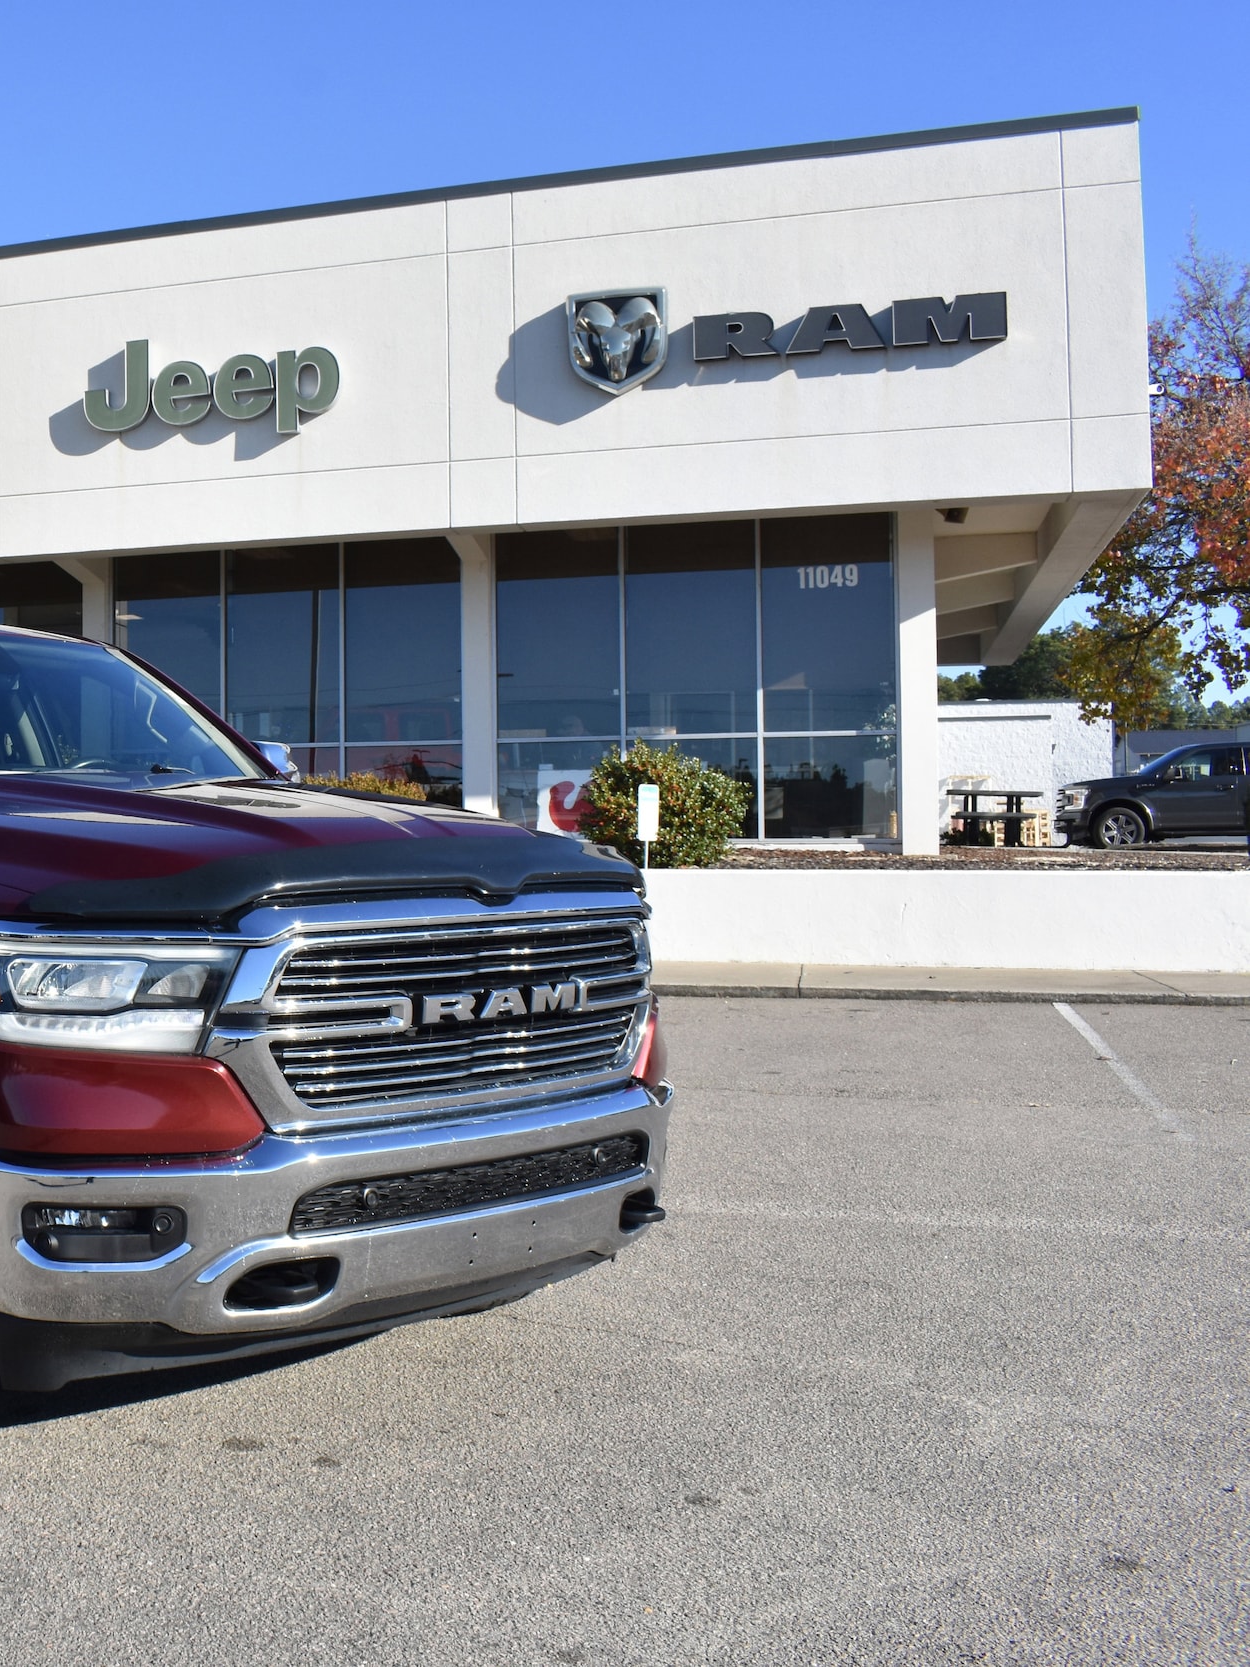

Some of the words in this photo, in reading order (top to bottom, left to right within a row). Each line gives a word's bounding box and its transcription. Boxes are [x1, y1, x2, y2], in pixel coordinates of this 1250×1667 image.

[693, 291, 1008, 361] RAM
[83, 338, 341, 435] Jeep
[797, 564, 859, 589] 11049
[422, 981, 576, 1025] RAM
